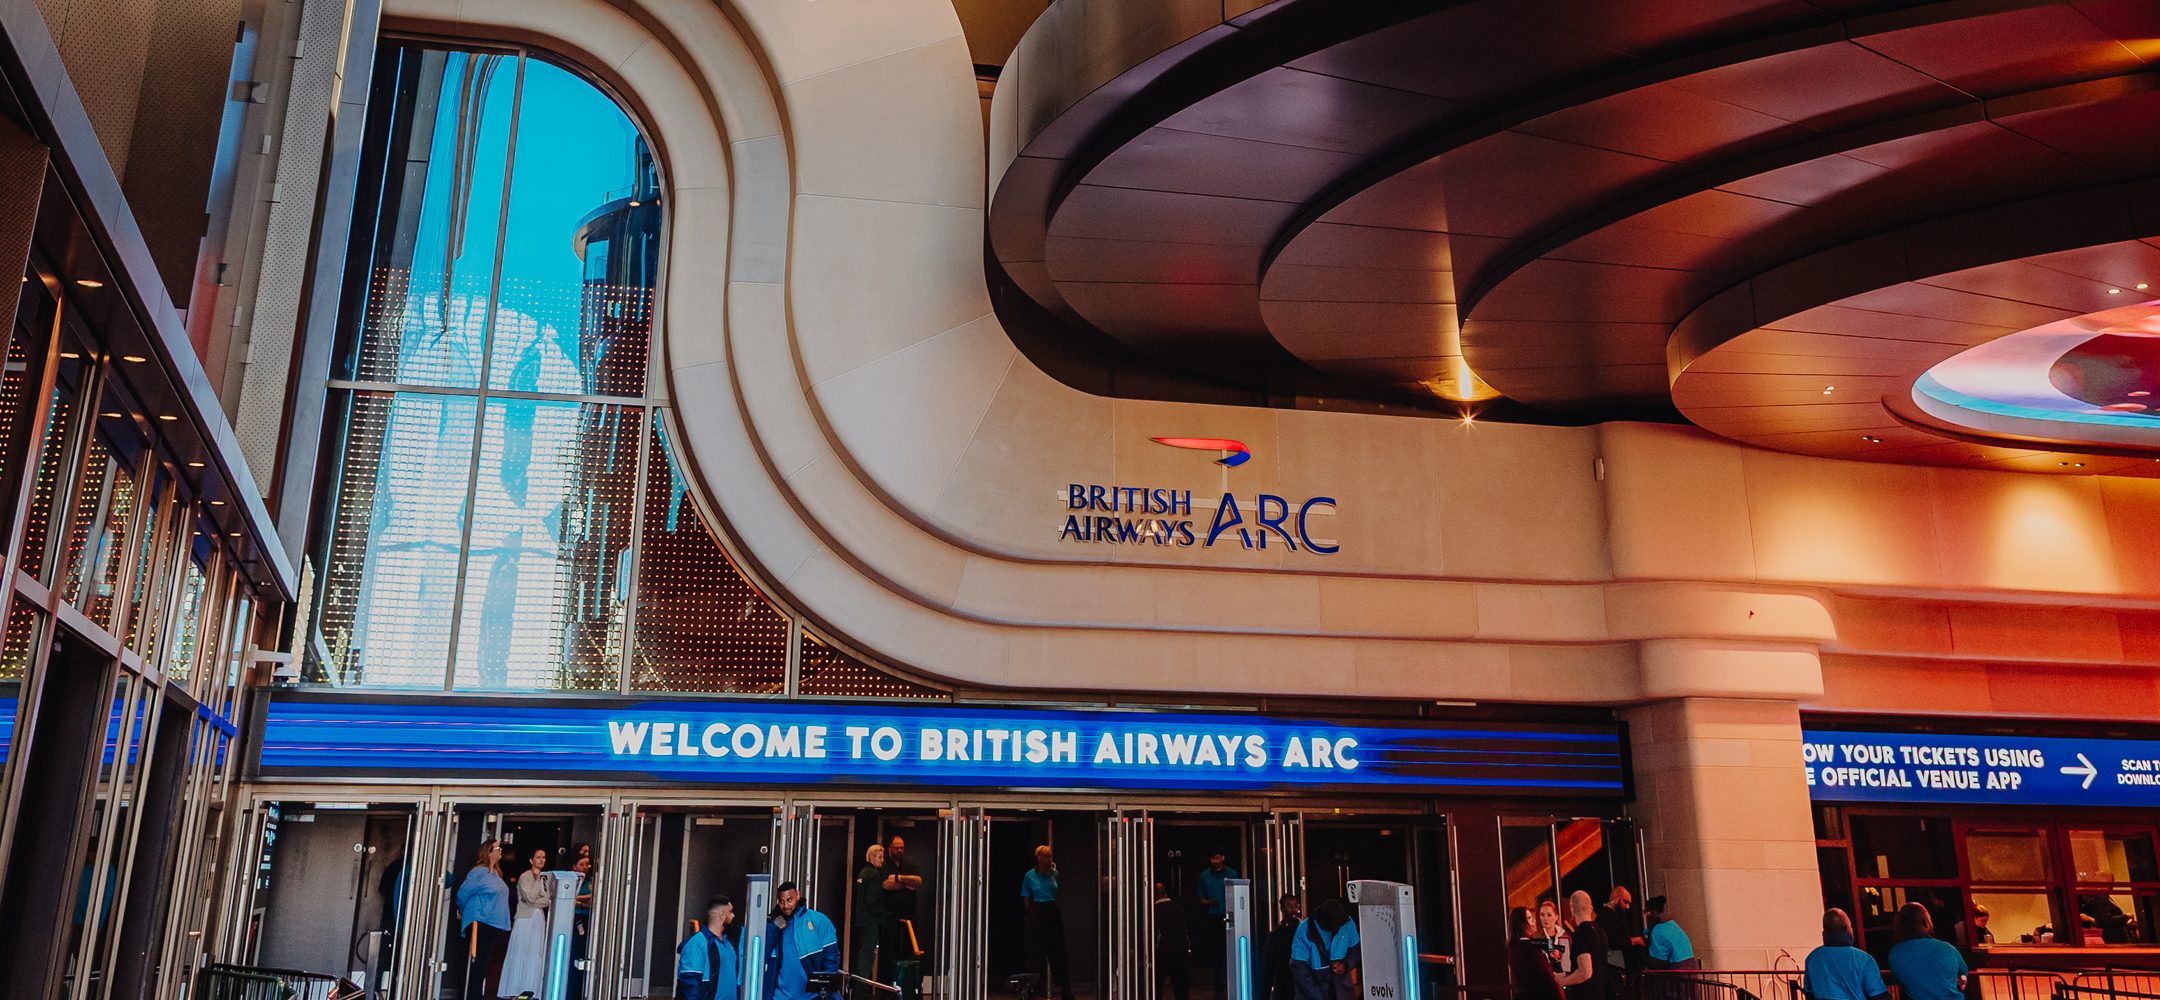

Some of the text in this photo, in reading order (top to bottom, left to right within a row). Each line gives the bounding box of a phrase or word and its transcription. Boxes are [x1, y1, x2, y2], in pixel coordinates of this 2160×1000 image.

[1067, 483, 1191, 516] BRITISH
[1059, 515, 1196, 546] AIRWAYS
[1203, 492, 1340, 554] ARC
[608, 721, 1359, 770] WELCOME TO BRITISH AIRWAYS ARC
[1803, 743, 2045, 768] OW YOUR TICKETS USING
[1821, 766, 1912, 788] OFFICIAL
[1917, 769, 1981, 790] VENUE
[1986, 771, 2022, 790] APP
[2121, 759, 2152, 771] SCAN
[1370, 983, 1394, 998] evolv
